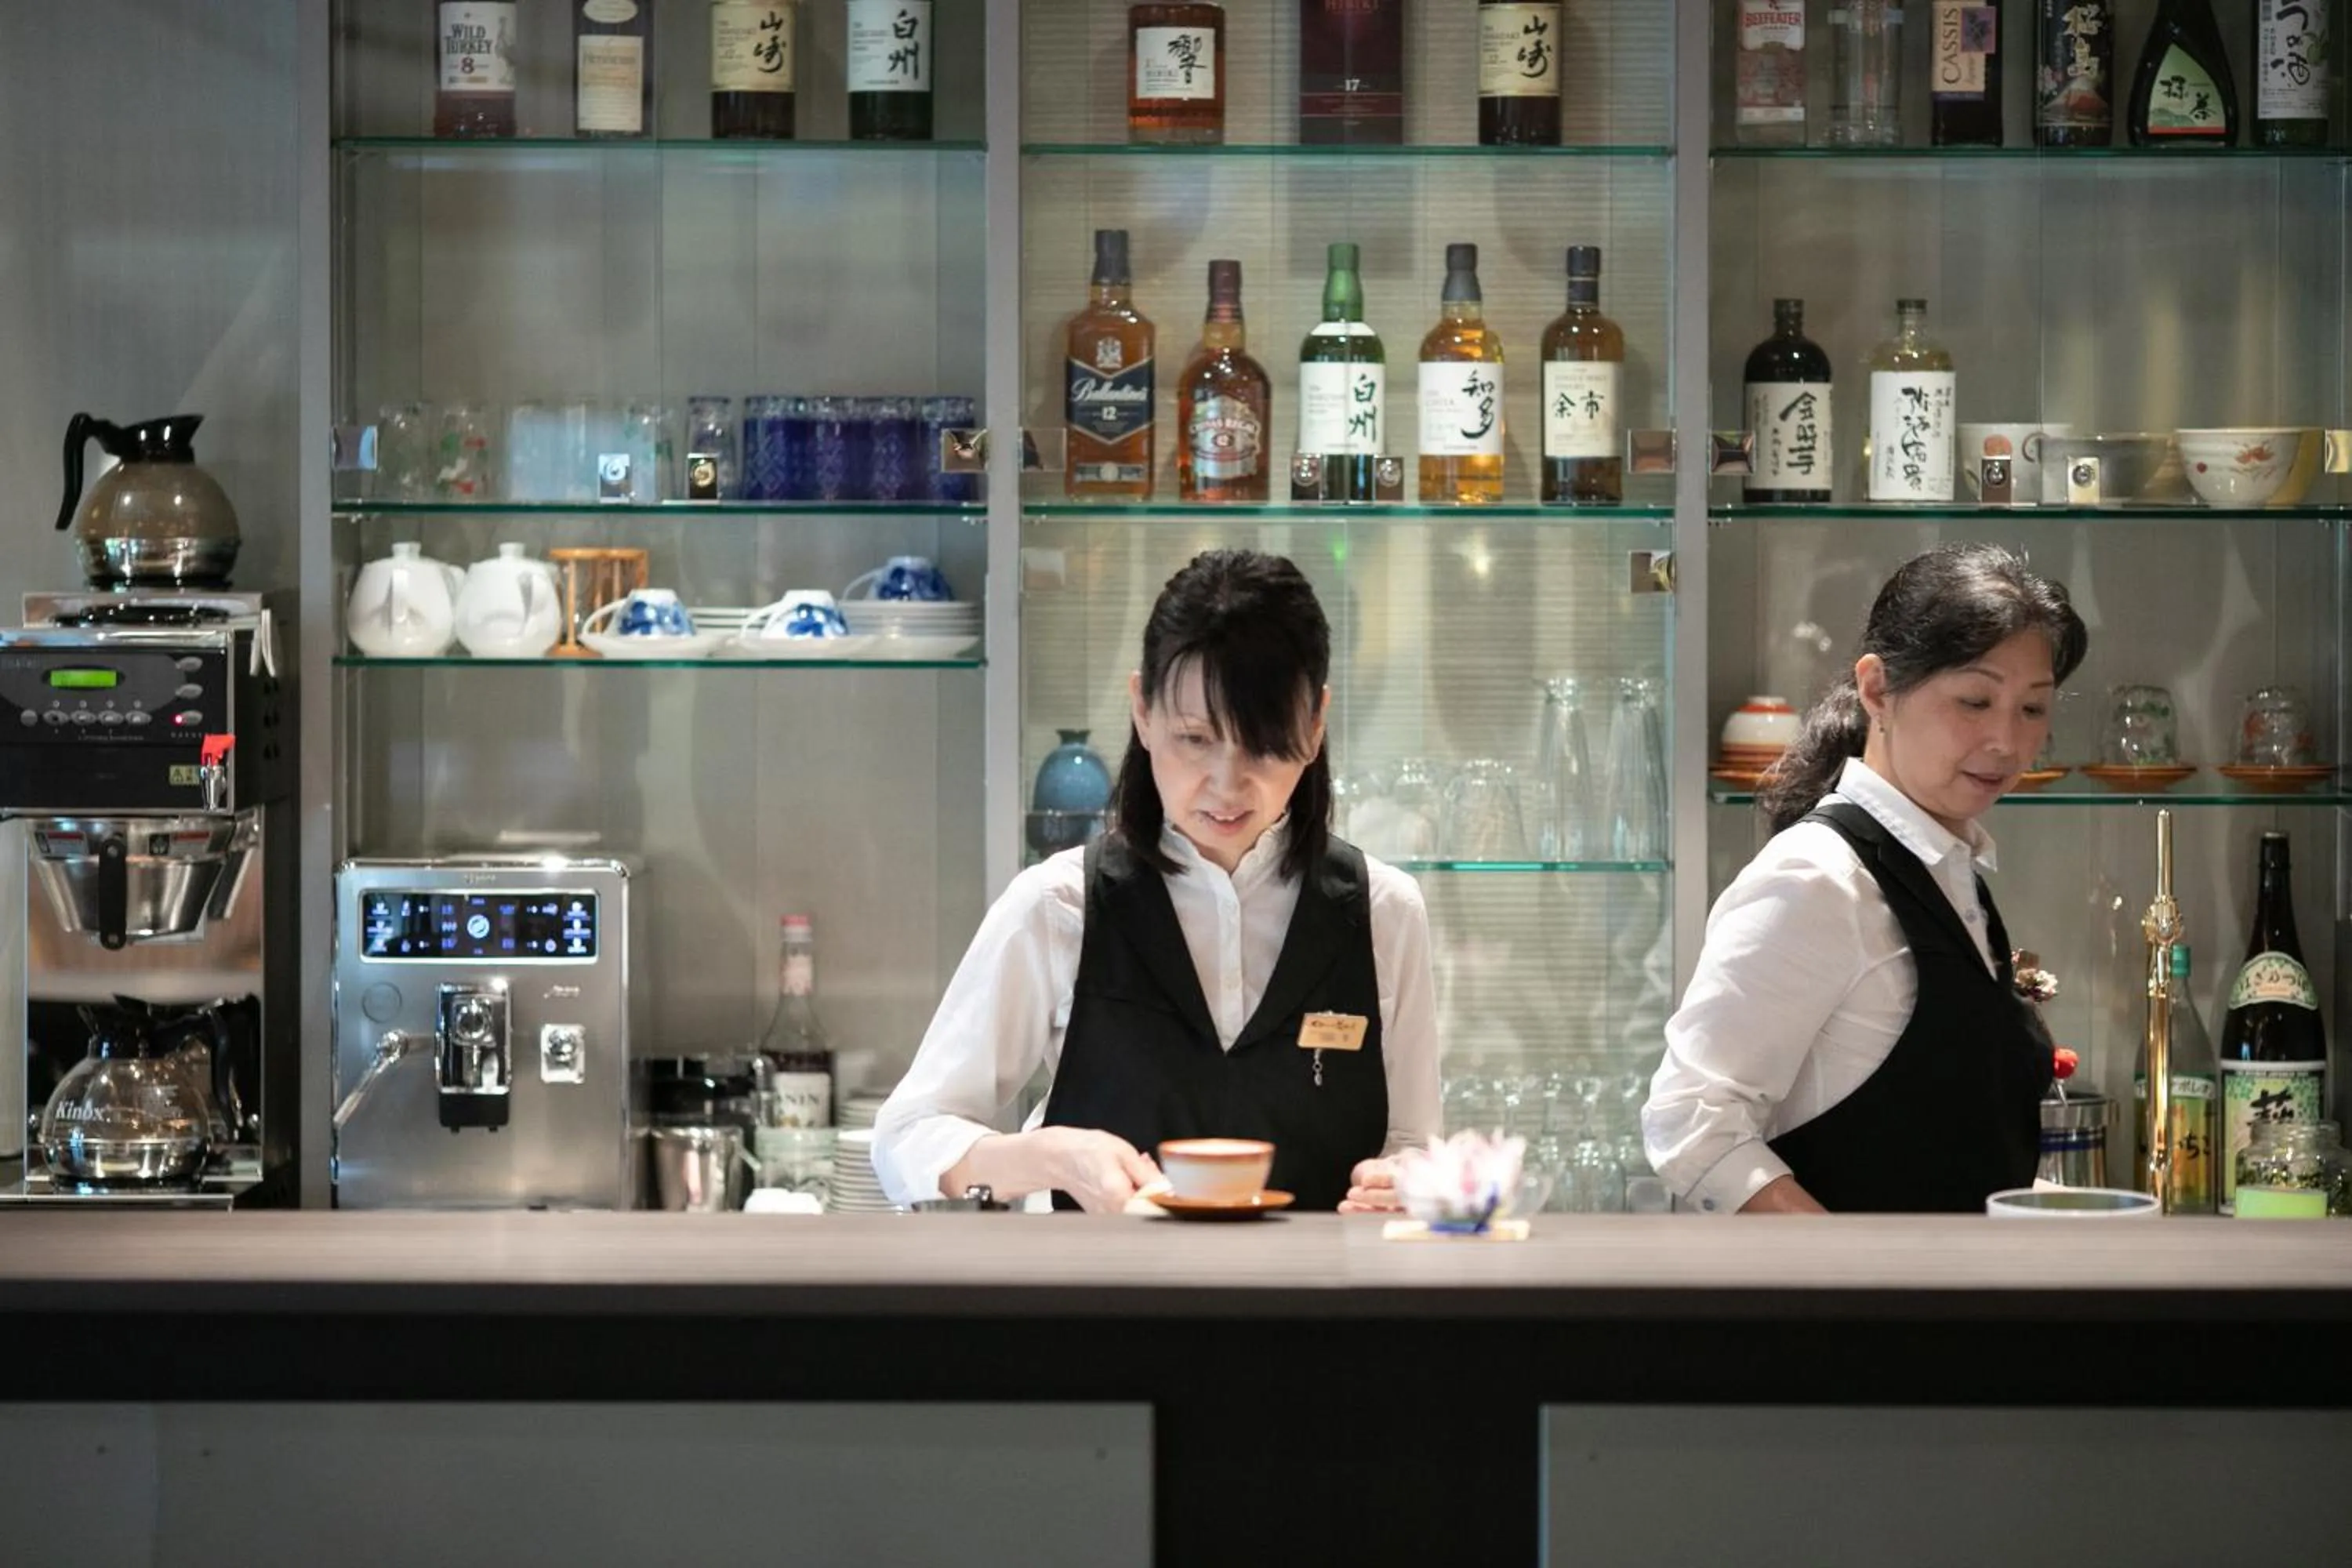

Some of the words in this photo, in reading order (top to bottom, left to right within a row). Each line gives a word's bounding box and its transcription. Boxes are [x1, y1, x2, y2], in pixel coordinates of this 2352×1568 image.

[1744, 12, 1802, 27] BEEFEATER
[451, 24, 486, 39] WILD
[445, 36, 493, 55] TURKEY
[887, 9, 919, 80] 白州
[1942, 8, 1961, 84] CASSIS
[460, 56, 475, 74] 8
[1345, 79, 1360, 92] 17
[1102, 405, 1117, 421] 12
[1348, 373, 1377, 443] 白州
[1552, 390, 1605, 419] 余市
[56, 1099, 104, 1121] Kinox
